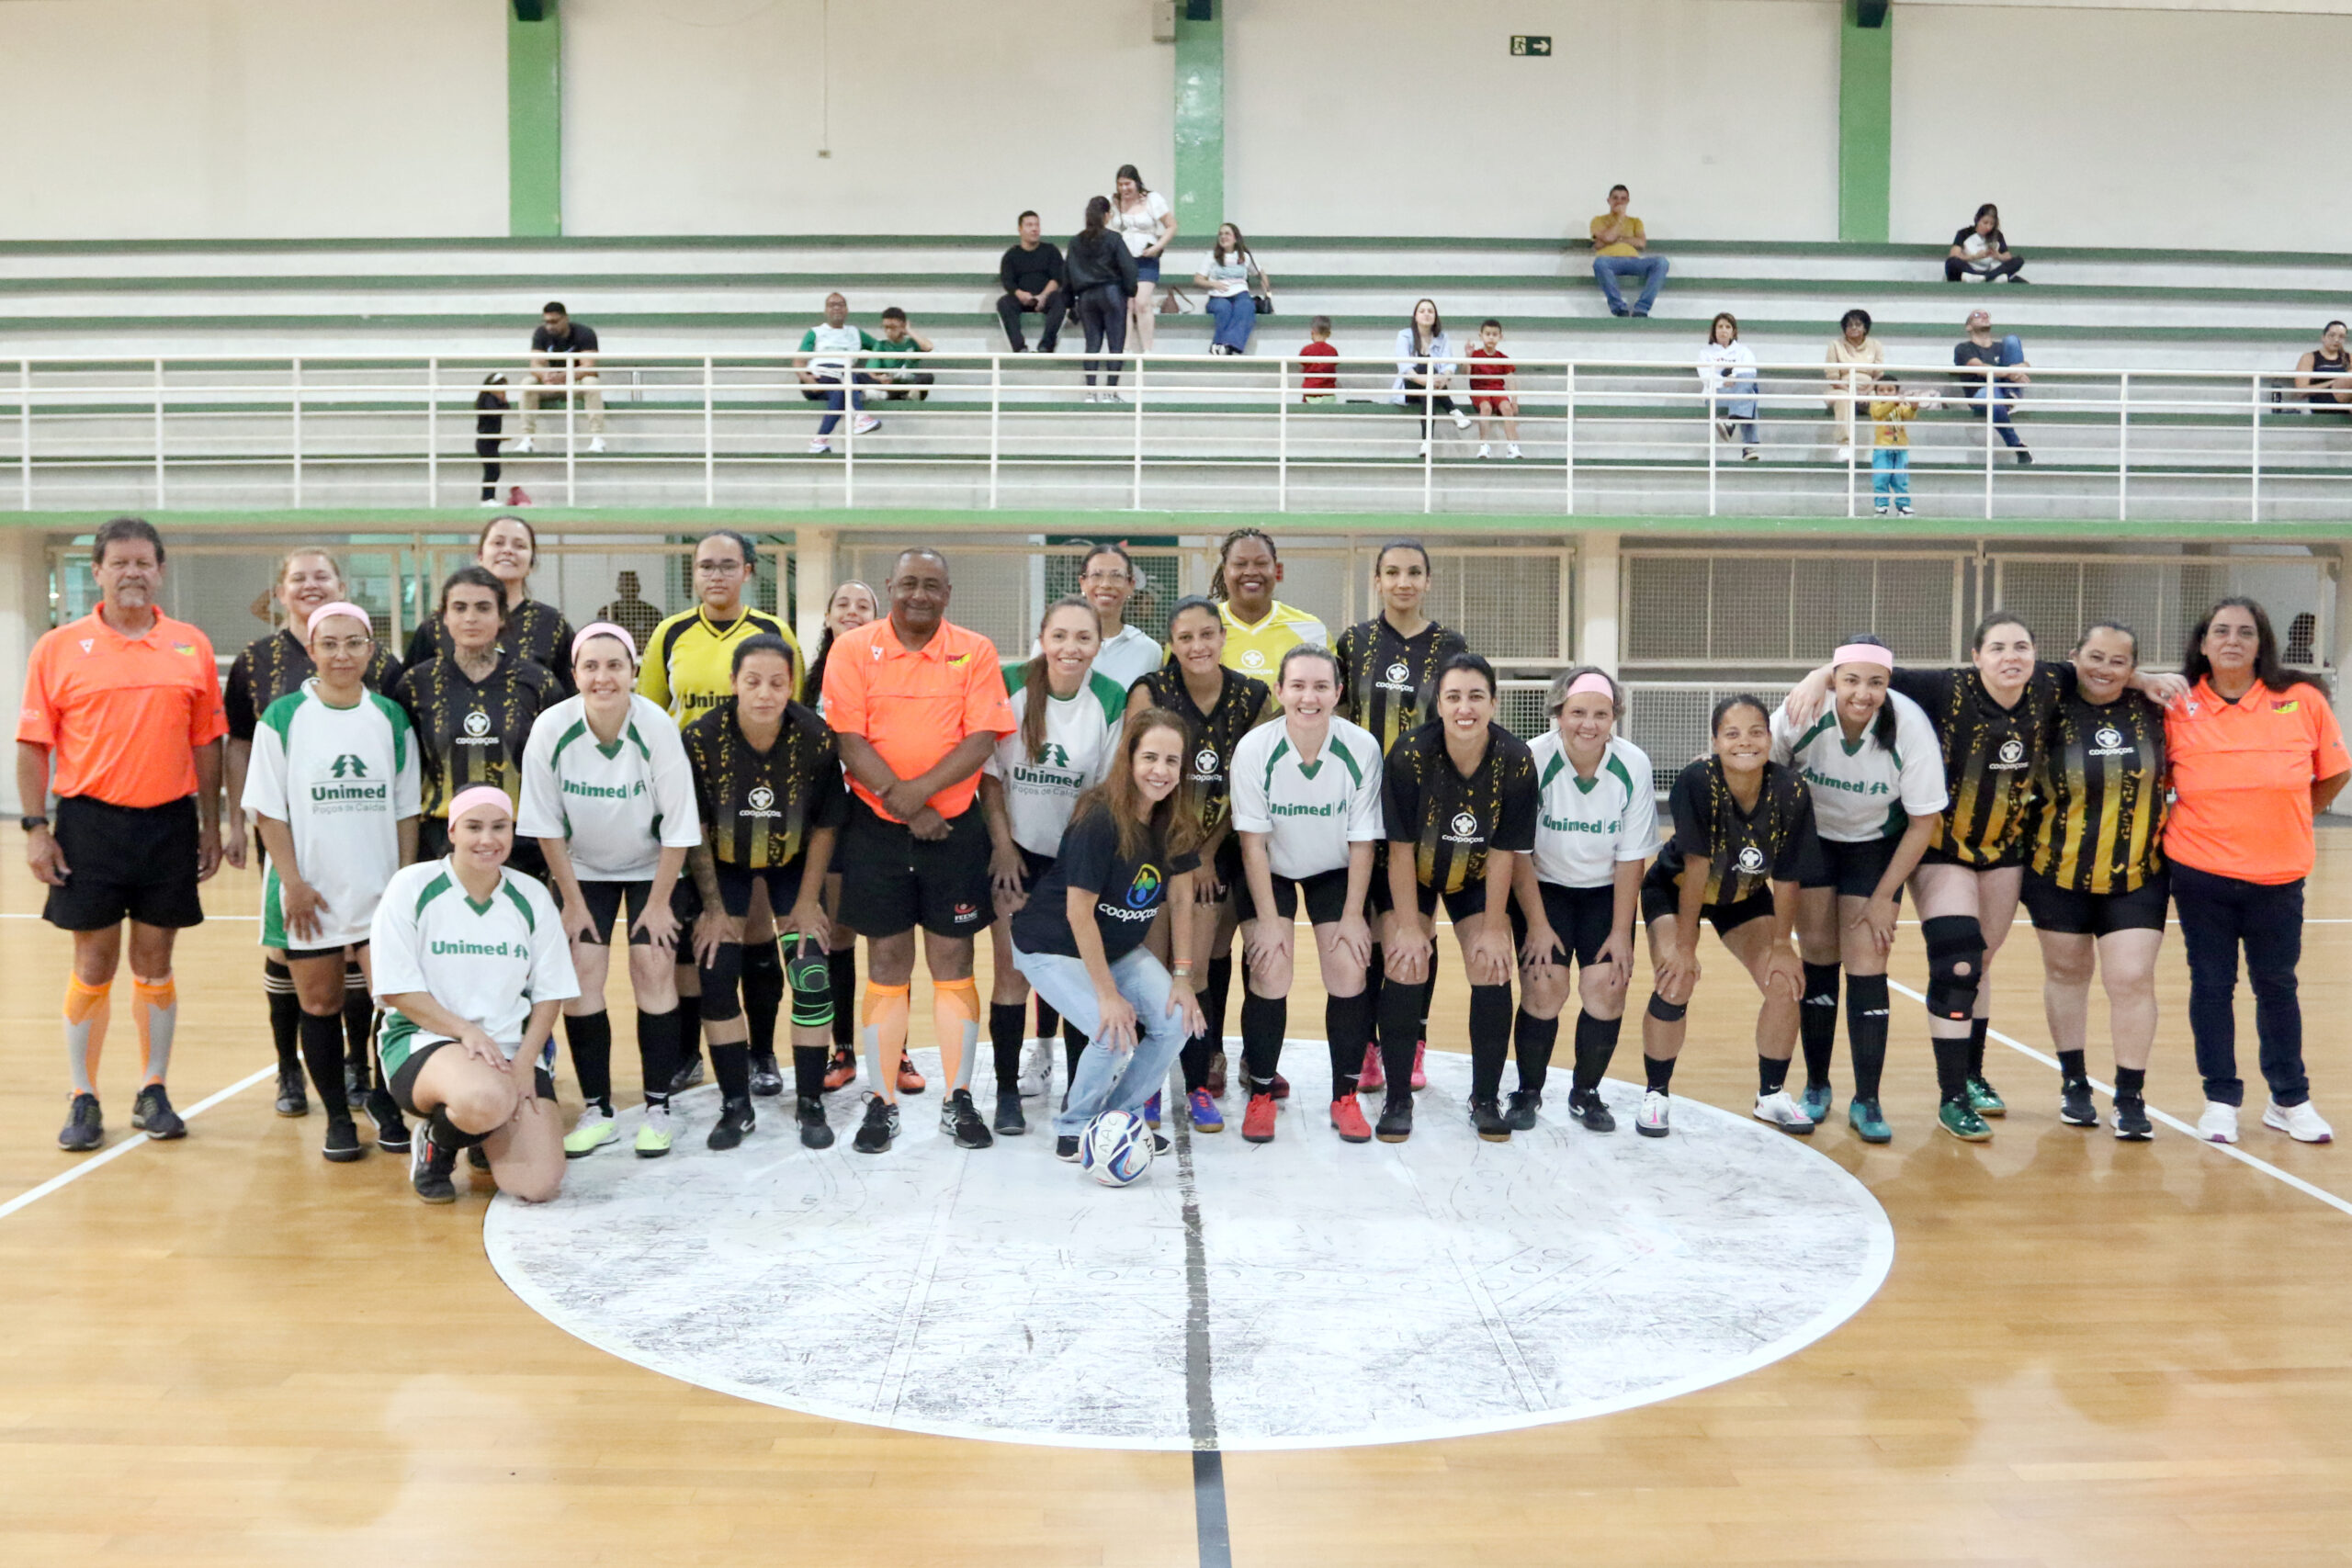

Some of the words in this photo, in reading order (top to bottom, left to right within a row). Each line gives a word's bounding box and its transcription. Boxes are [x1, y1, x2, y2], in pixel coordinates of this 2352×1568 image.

[2088, 746, 2134, 757] coopaços
[1013, 766, 1085, 788] Unimed
[311, 784, 387, 801] Unimed
[1053, 788, 1081, 799] Calda
[1543, 815, 1602, 834] Unimed
[1098, 903, 1159, 922] coopaços
[431, 940, 508, 956] Unimed
